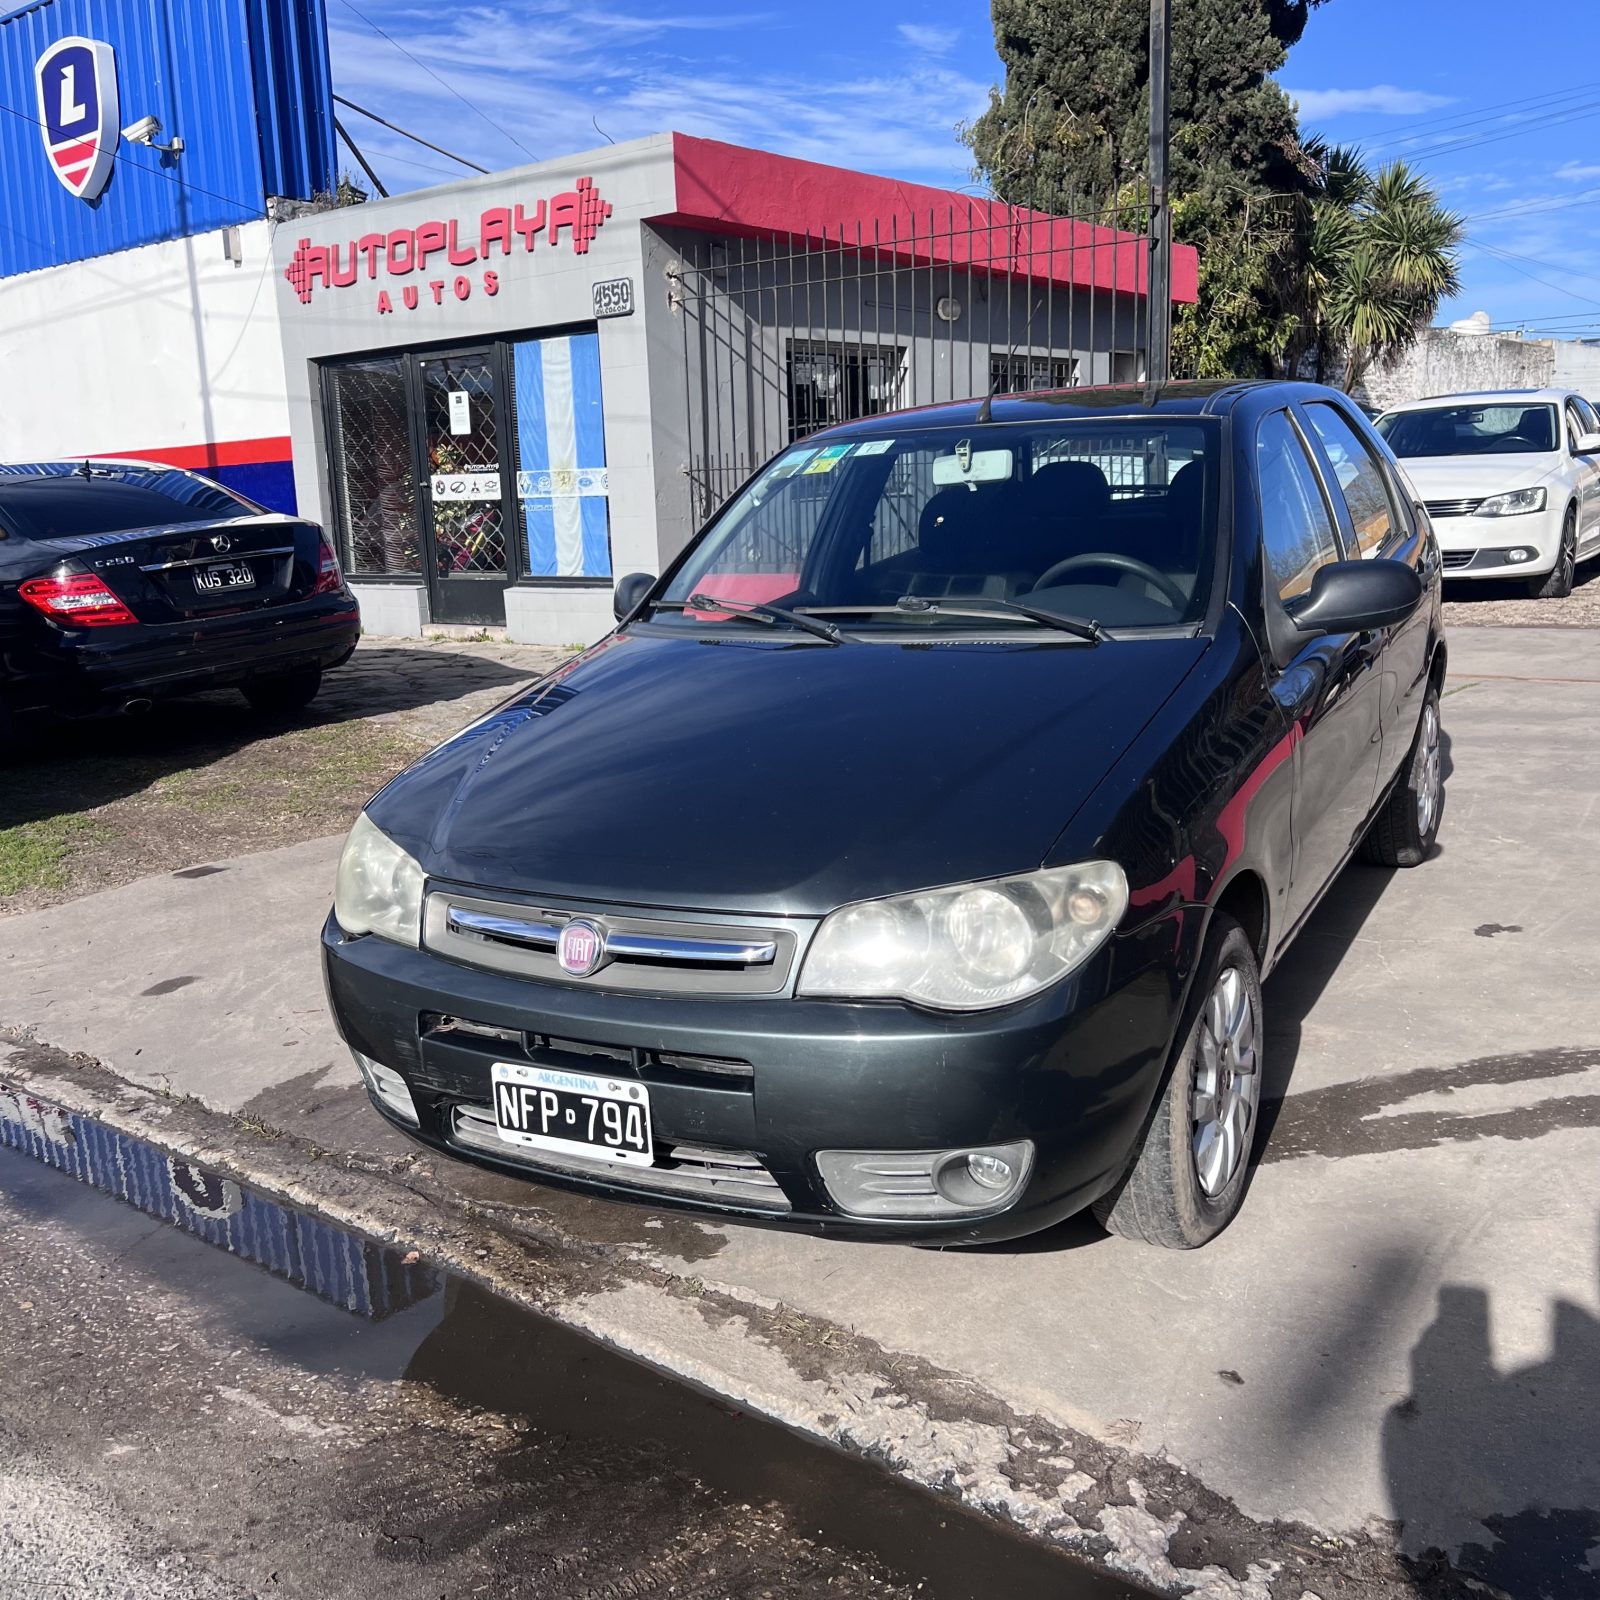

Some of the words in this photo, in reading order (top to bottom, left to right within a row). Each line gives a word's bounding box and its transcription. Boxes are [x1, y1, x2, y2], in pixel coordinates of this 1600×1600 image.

[304, 191, 582, 290] AUTOPLAYA
[377, 271, 500, 314] AUTOS
[594, 282, 629, 308] 4550
[95, 560, 104, 568] C
[106, 556, 135, 566] 250
[197, 572, 222, 590] KUS
[226, 567, 252, 585] 320
[565, 936, 592, 962] FIAT
[537, 1072, 599, 1092] ARGENTINA
[499, 1084, 559, 1134] NFP
[581, 1097, 645, 1150] 794
